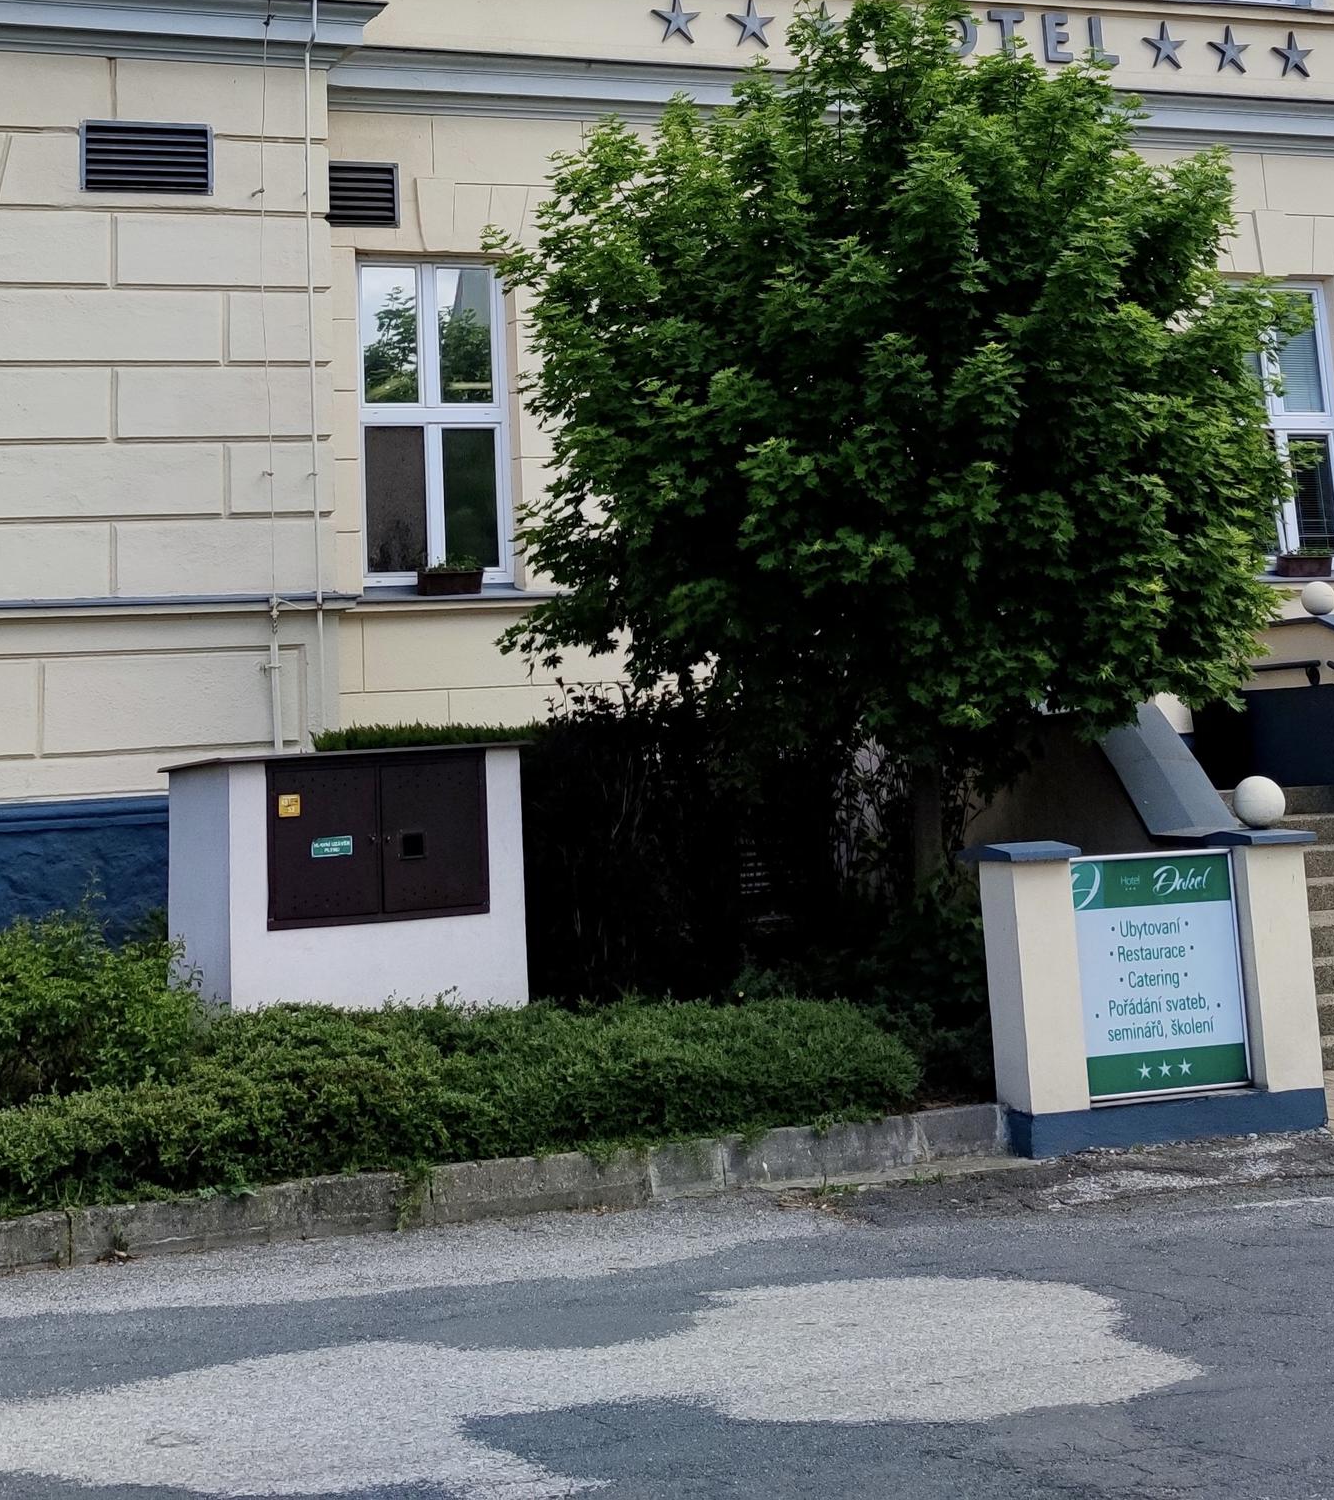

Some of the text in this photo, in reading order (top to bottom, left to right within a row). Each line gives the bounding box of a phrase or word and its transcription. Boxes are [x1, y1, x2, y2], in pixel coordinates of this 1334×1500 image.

[895, 5, 1120, 66] OTEL
[1120, 875, 1140, 886] Hotel
[1117, 945, 1186, 963] Restaurace
[1128, 969, 1180, 988] Catering
[1109, 992, 1210, 1018] Pořádání svateb,
[1108, 1015, 1214, 1042] seminářů, školení
